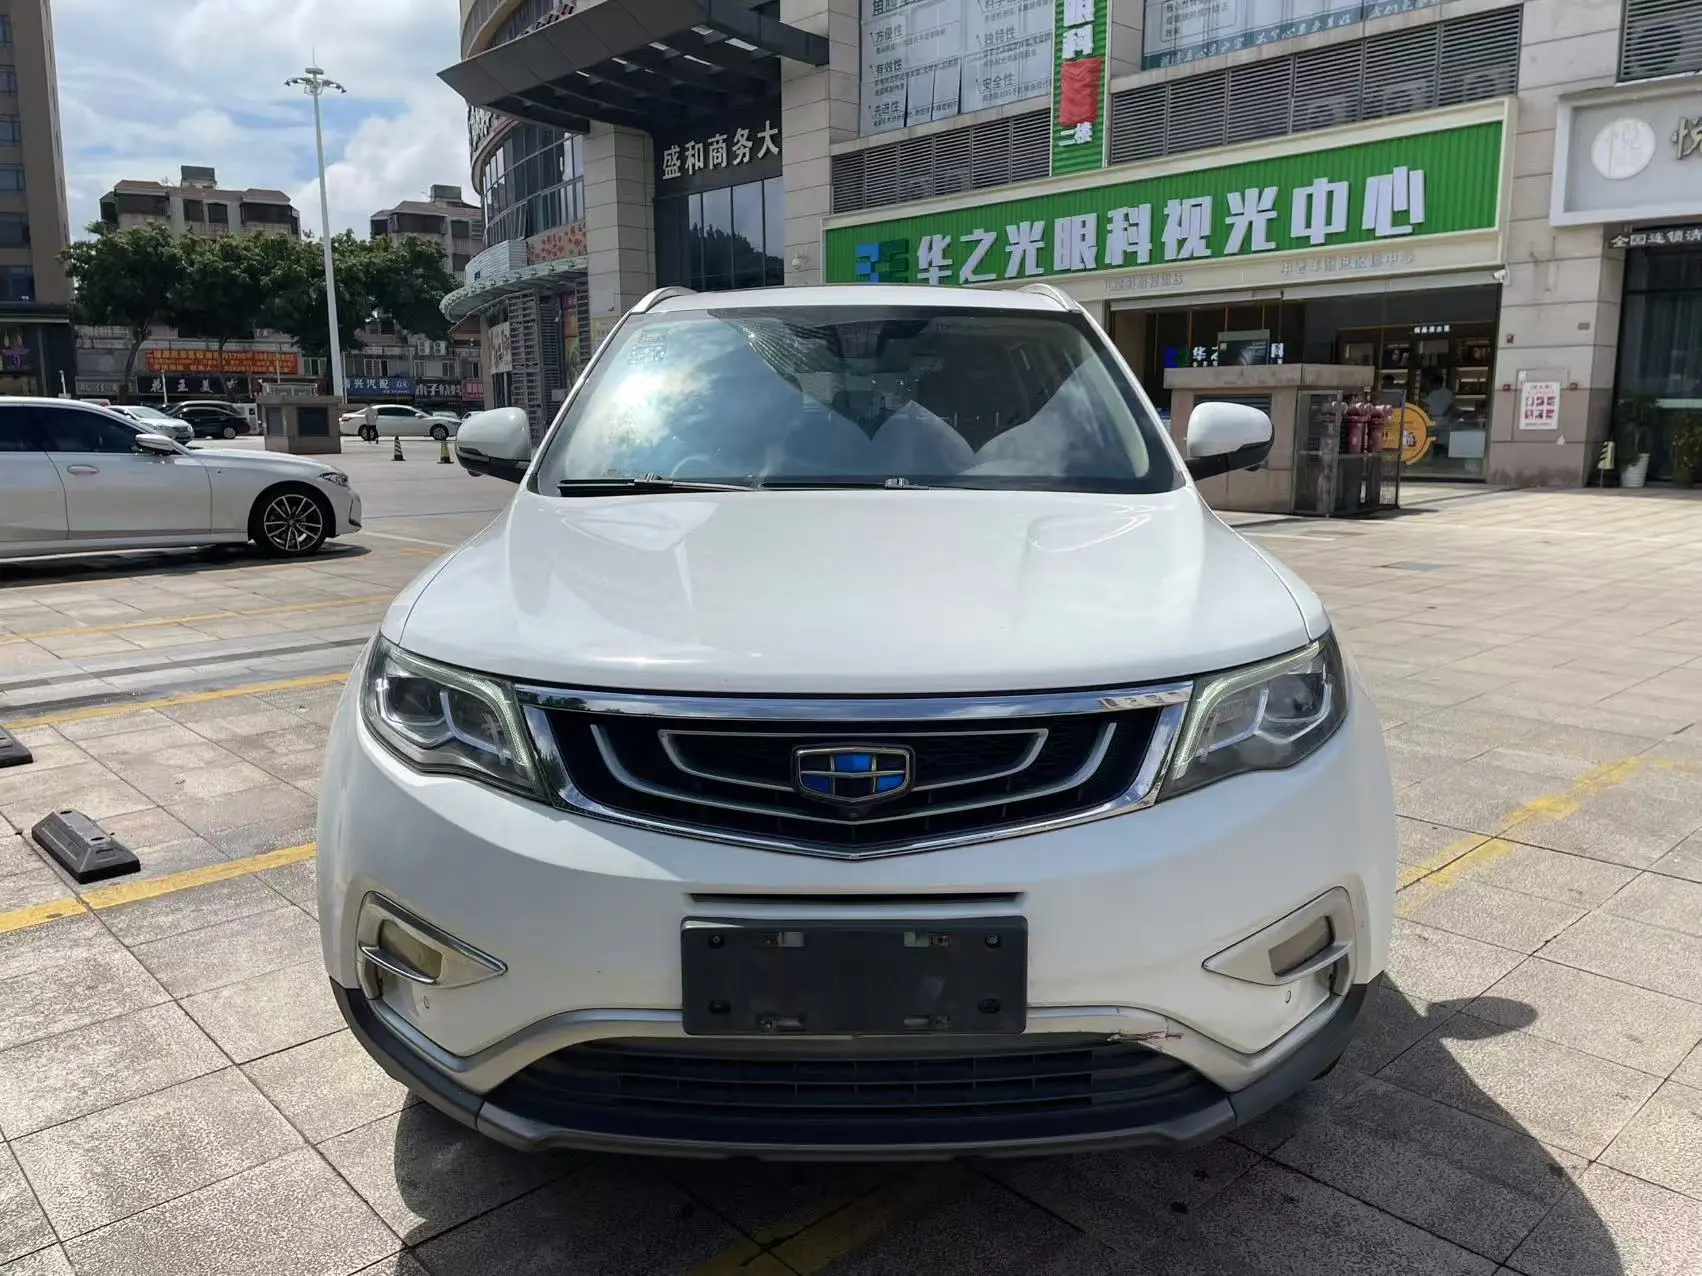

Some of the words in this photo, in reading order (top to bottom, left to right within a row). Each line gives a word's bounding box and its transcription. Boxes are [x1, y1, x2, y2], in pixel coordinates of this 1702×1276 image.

[662, 119, 780, 180] 盛和商务大
[916, 166, 1426, 285] 华之光眼科视光中心
